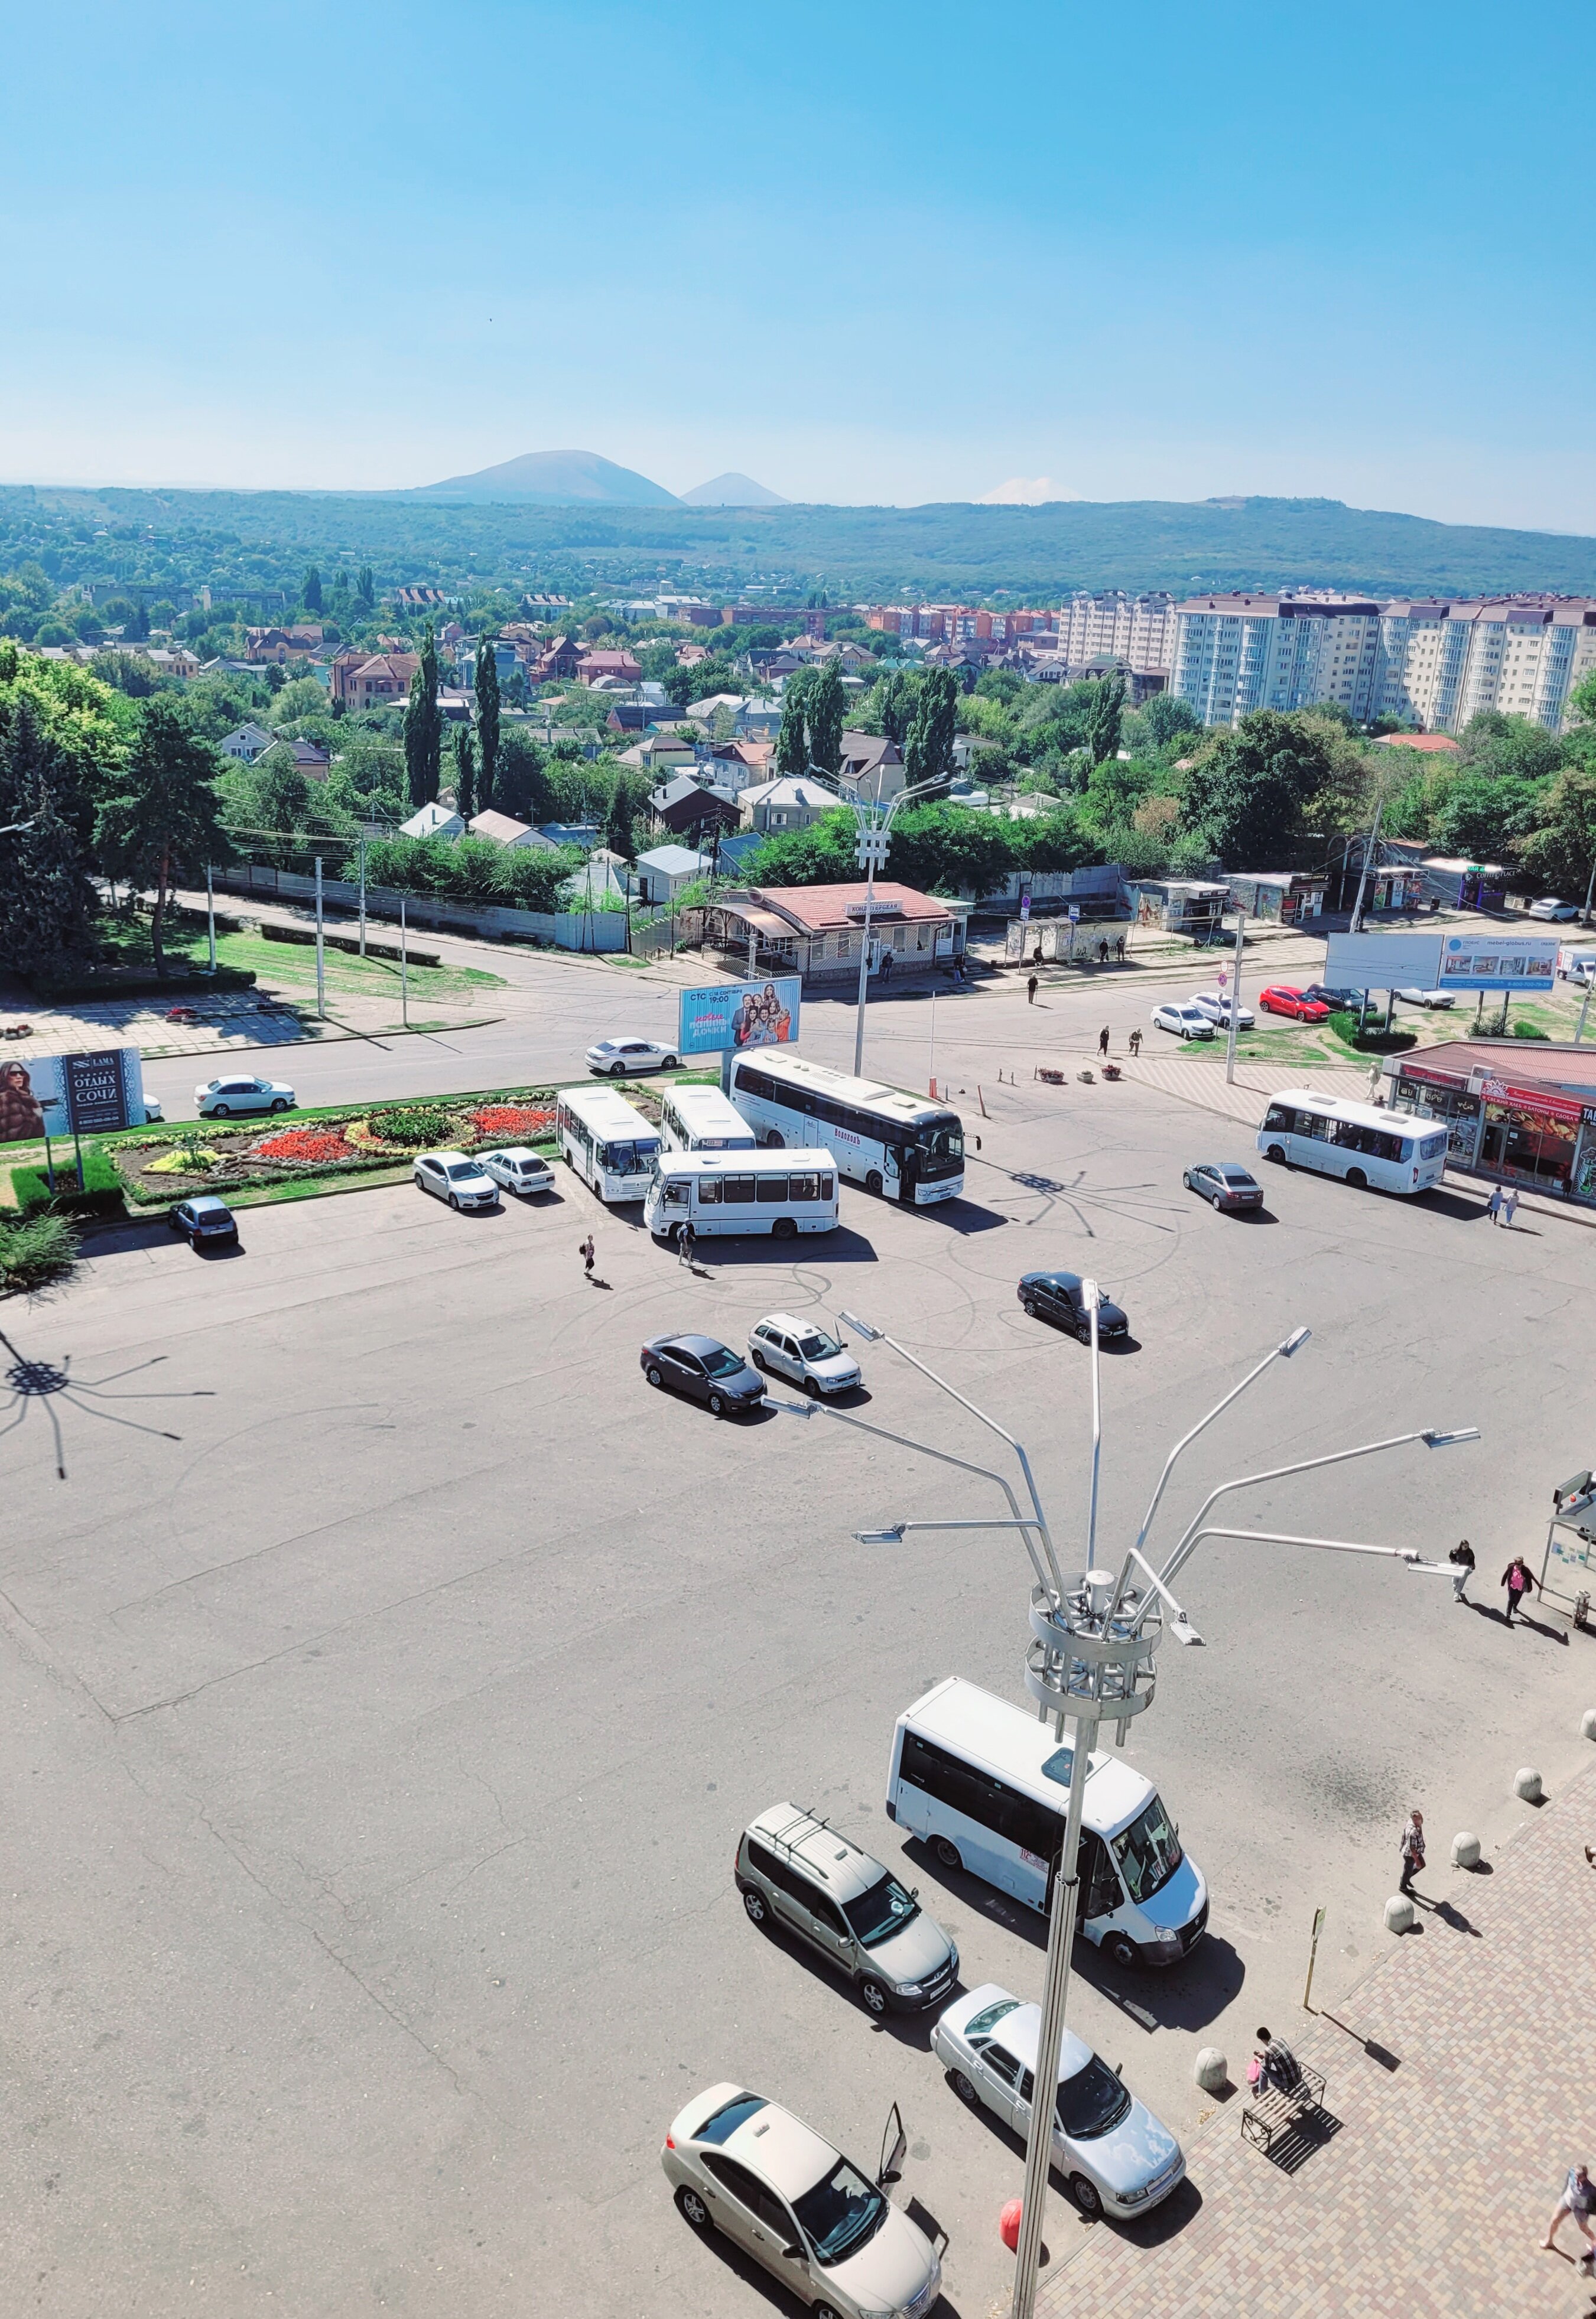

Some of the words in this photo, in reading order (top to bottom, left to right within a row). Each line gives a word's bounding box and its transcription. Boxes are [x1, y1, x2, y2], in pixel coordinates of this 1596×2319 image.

[709, 995, 729, 1003] 19:00
[74, 1075, 116, 1087] ОТДЫХ
[76, 1088, 118, 1102] СОЧИ
[1487, 1097, 1508, 1105] СВЕЖИЙ
[1527, 1106, 1549, 1115] БАТОНЫ
